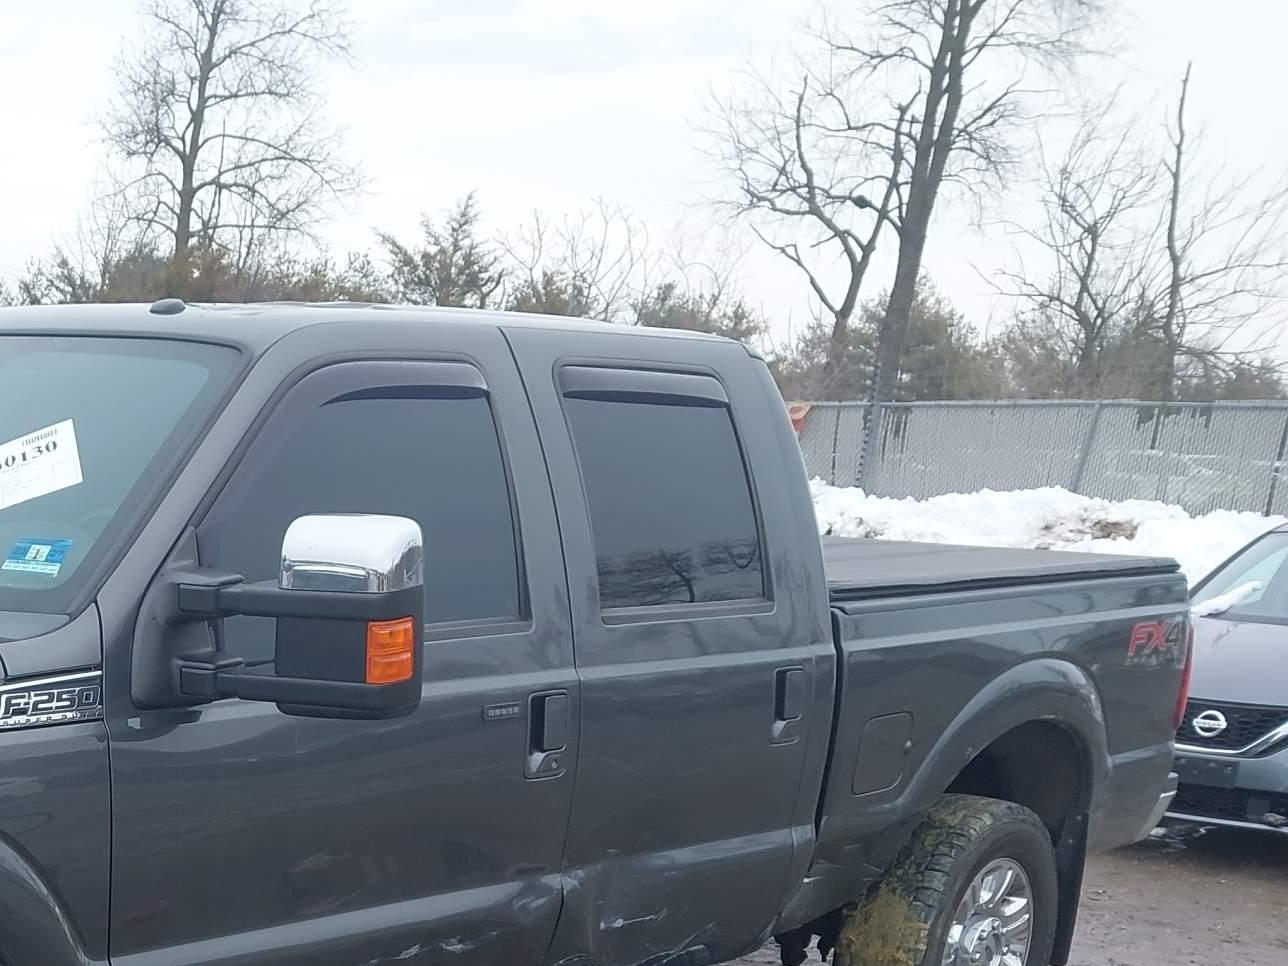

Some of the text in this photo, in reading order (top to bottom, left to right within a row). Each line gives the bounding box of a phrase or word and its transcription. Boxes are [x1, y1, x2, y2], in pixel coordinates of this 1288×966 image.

[33, 548, 41, 560] 1
[1127, 615, 1183, 656] FX4
[2, 716, 53, 727] SUPER
